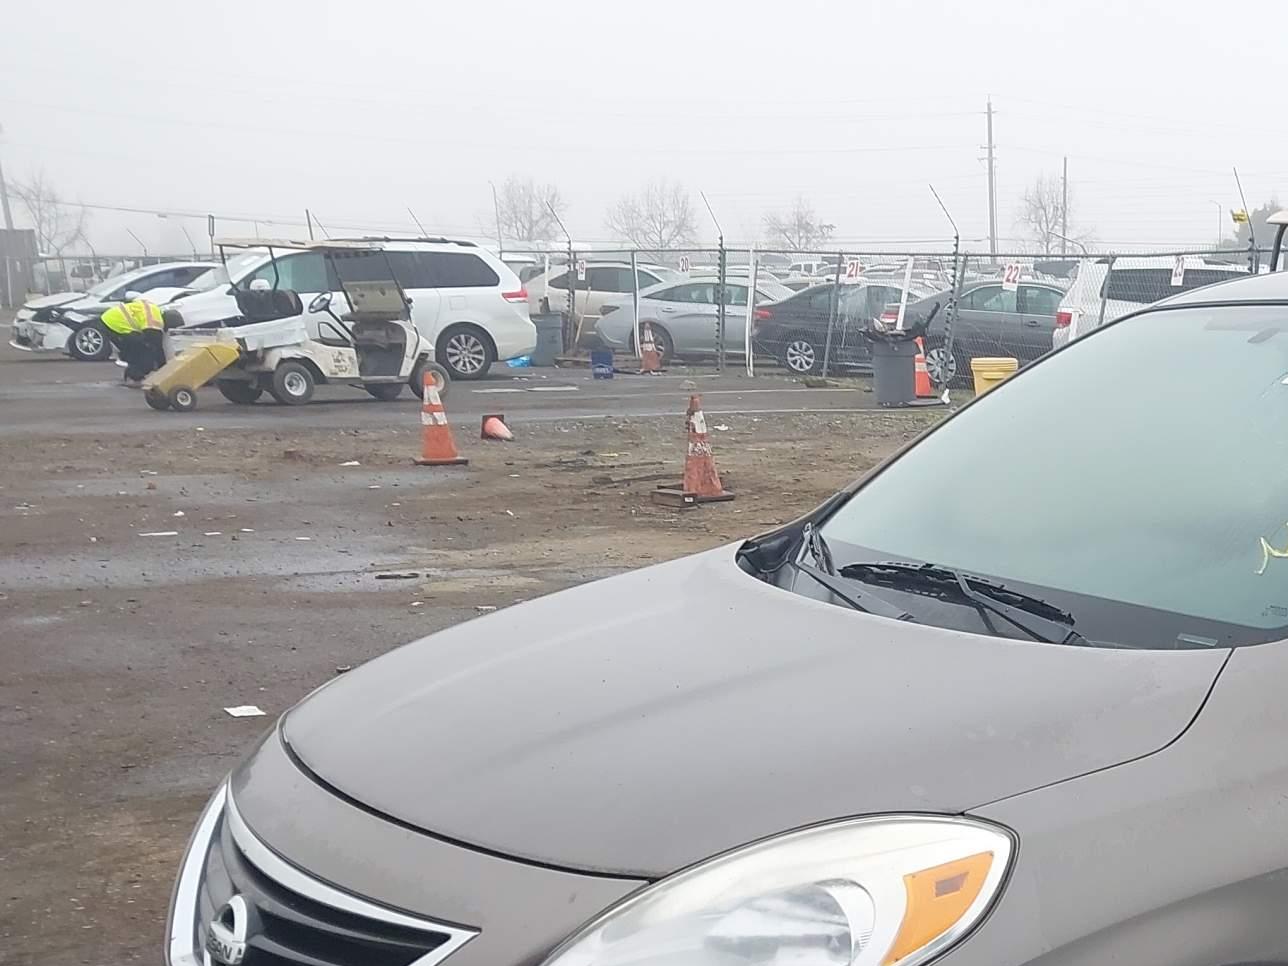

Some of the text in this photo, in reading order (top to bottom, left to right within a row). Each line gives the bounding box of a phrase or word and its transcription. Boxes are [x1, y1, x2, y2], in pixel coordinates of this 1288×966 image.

[680, 256, 690, 273] 20
[847, 261, 860, 279] 21
[1005, 264, 1020, 284] 22
